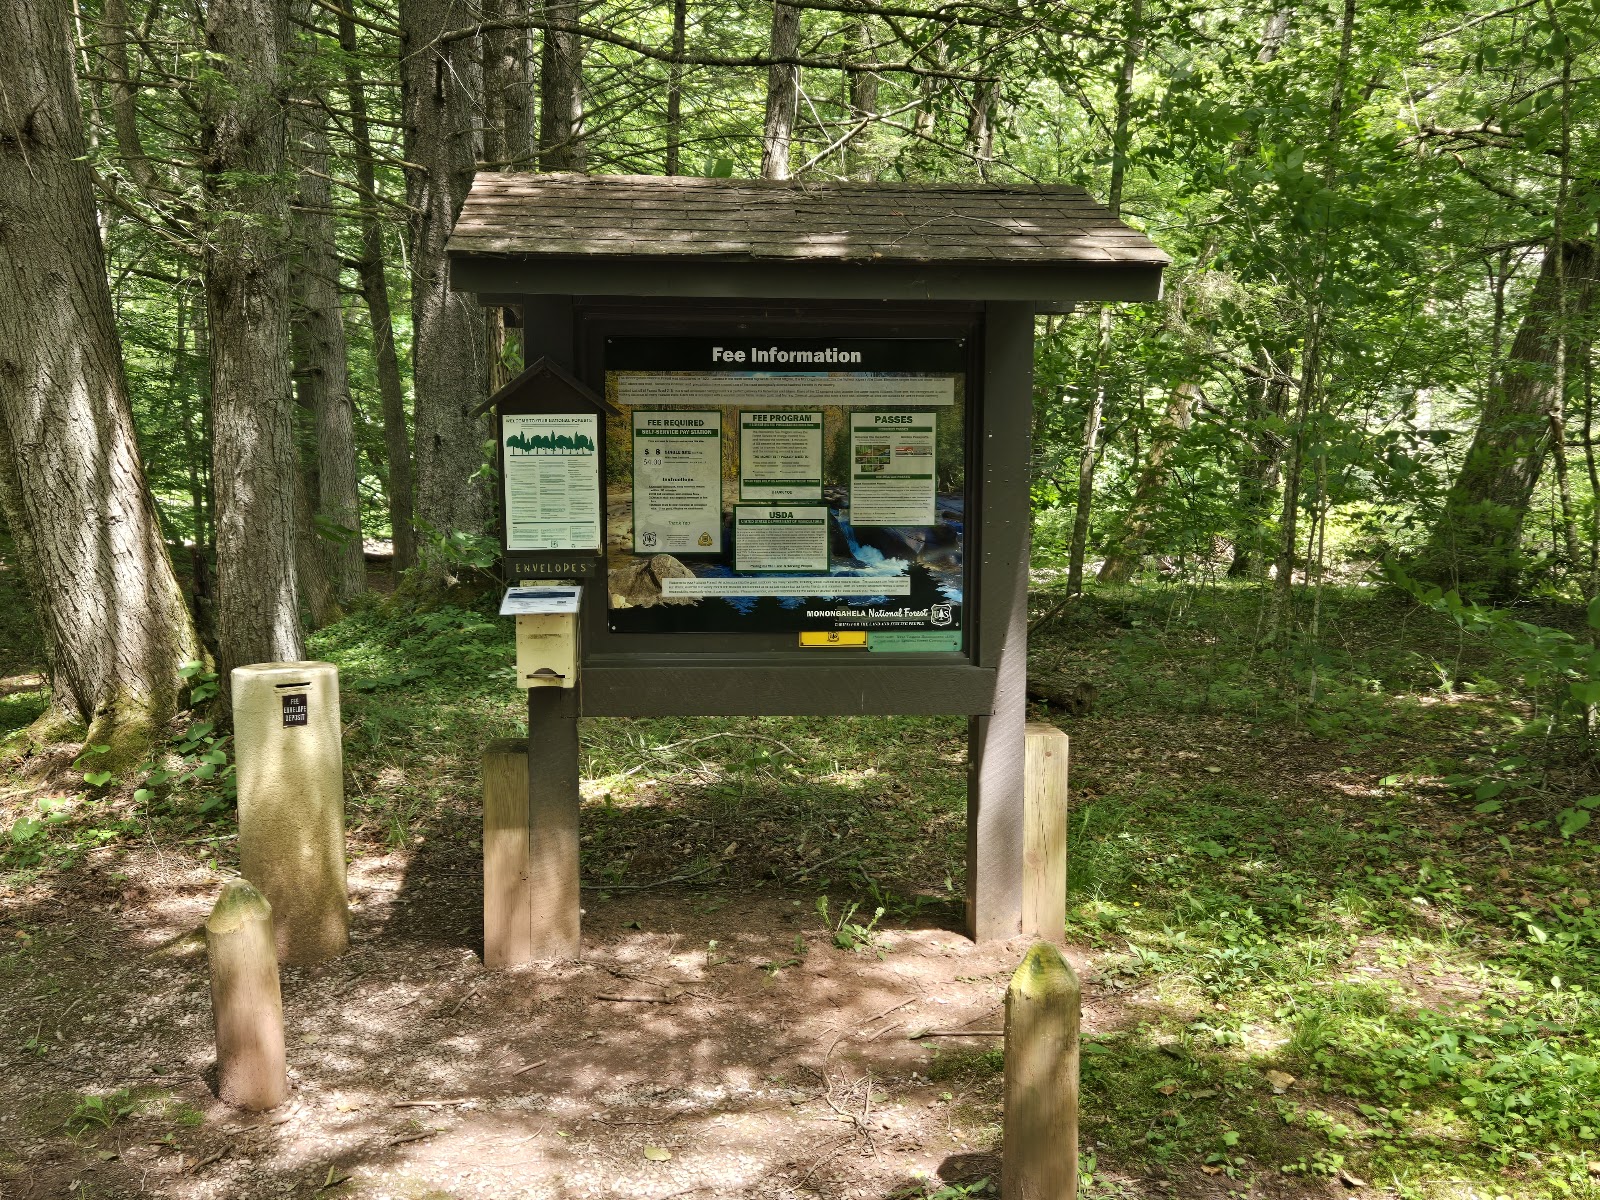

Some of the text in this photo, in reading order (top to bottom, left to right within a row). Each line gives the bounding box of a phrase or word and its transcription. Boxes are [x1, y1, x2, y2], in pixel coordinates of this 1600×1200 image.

[712, 346, 862, 363] Fee Information
[752, 414, 812, 422] FEE PROGRAM
[874, 415, 913, 424] PASSES
[647, 419, 705, 428] FEE REQUIRED
[768, 511, 794, 519] USDA
[515, 563, 587, 573] ENVELOPES
[868, 608, 903, 618] National
[904, 607, 929, 618] Forest
[285, 714, 305, 722] DEPOSIT
